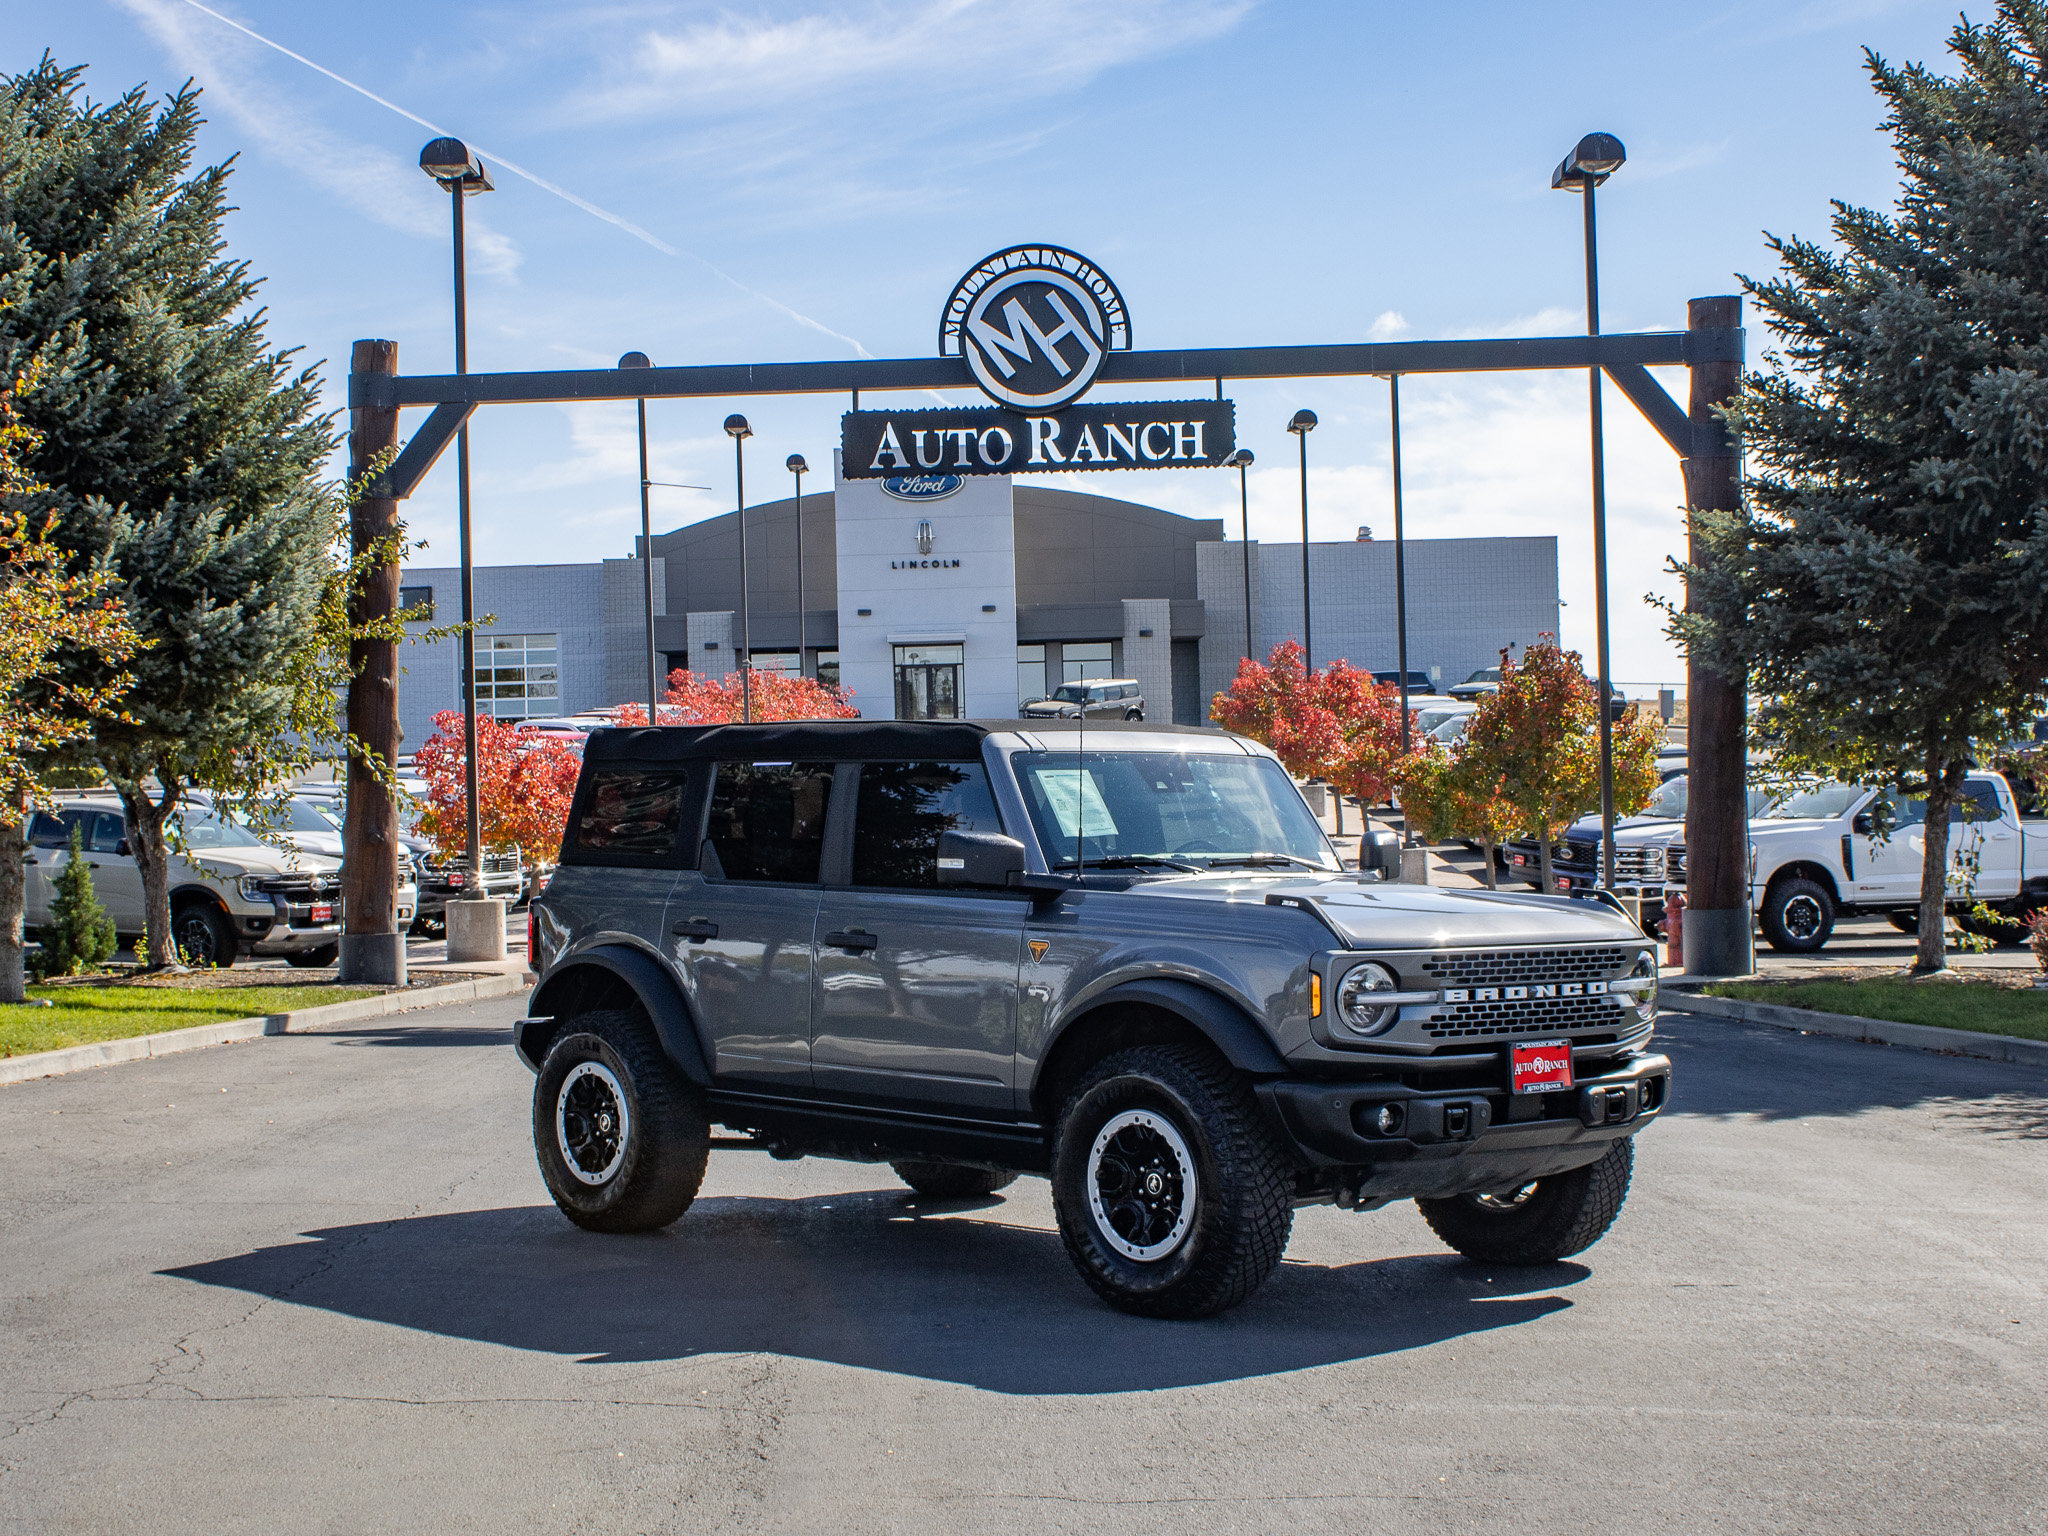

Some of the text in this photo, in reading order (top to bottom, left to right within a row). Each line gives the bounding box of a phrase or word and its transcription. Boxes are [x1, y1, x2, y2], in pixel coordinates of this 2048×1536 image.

[944, 248, 1127, 338] MOUNTAIN HOME
[869, 416, 1209, 470] AUTO RANCH
[899, 474, 946, 494] Ford
[891, 558, 961, 570] LINCOLN
[1444, 981, 1609, 1003] BRONCO
[1514, 1062, 1533, 1075] AUTO
[1544, 1060, 1568, 1072] RANCH
